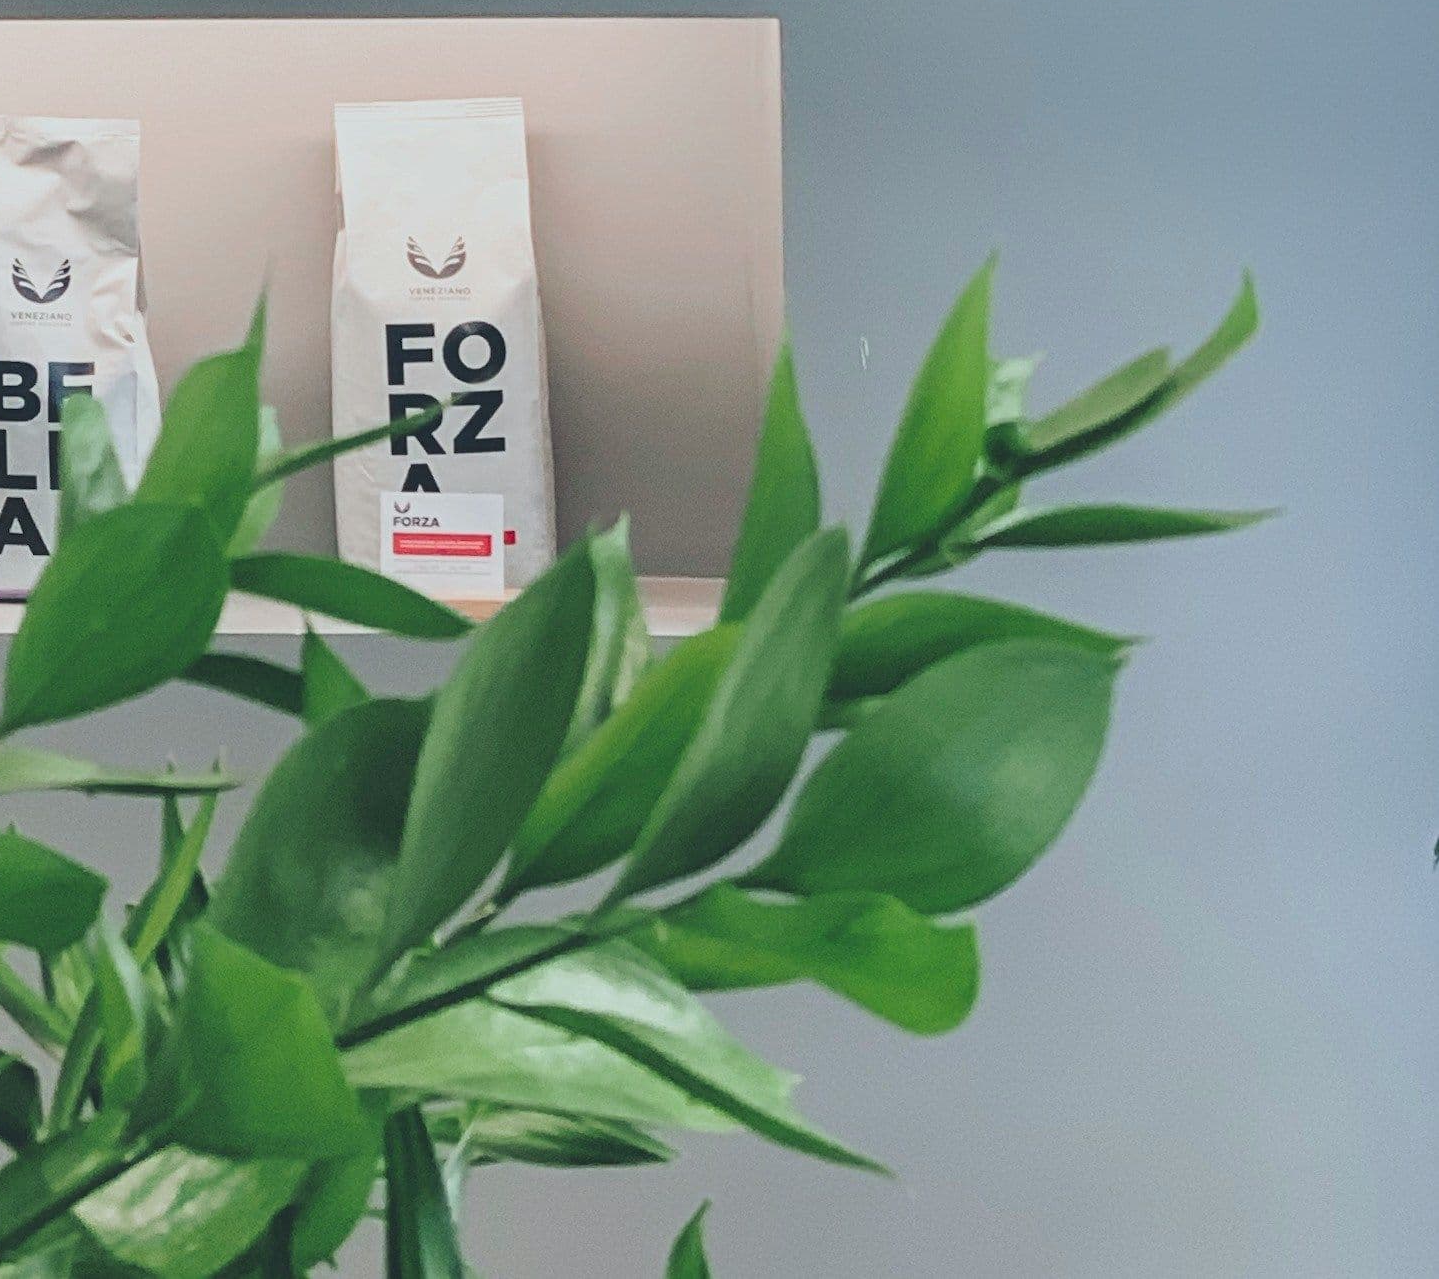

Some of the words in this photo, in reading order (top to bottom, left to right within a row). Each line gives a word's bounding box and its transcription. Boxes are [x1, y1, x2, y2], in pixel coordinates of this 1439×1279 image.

[409, 287, 471, 295] VENEZIANO
[11, 312, 72, 320] VENEZIANO
[385, 321, 506, 385] FO
[388, 390, 506, 456] RZ
[393, 517, 440, 527] FORZA
